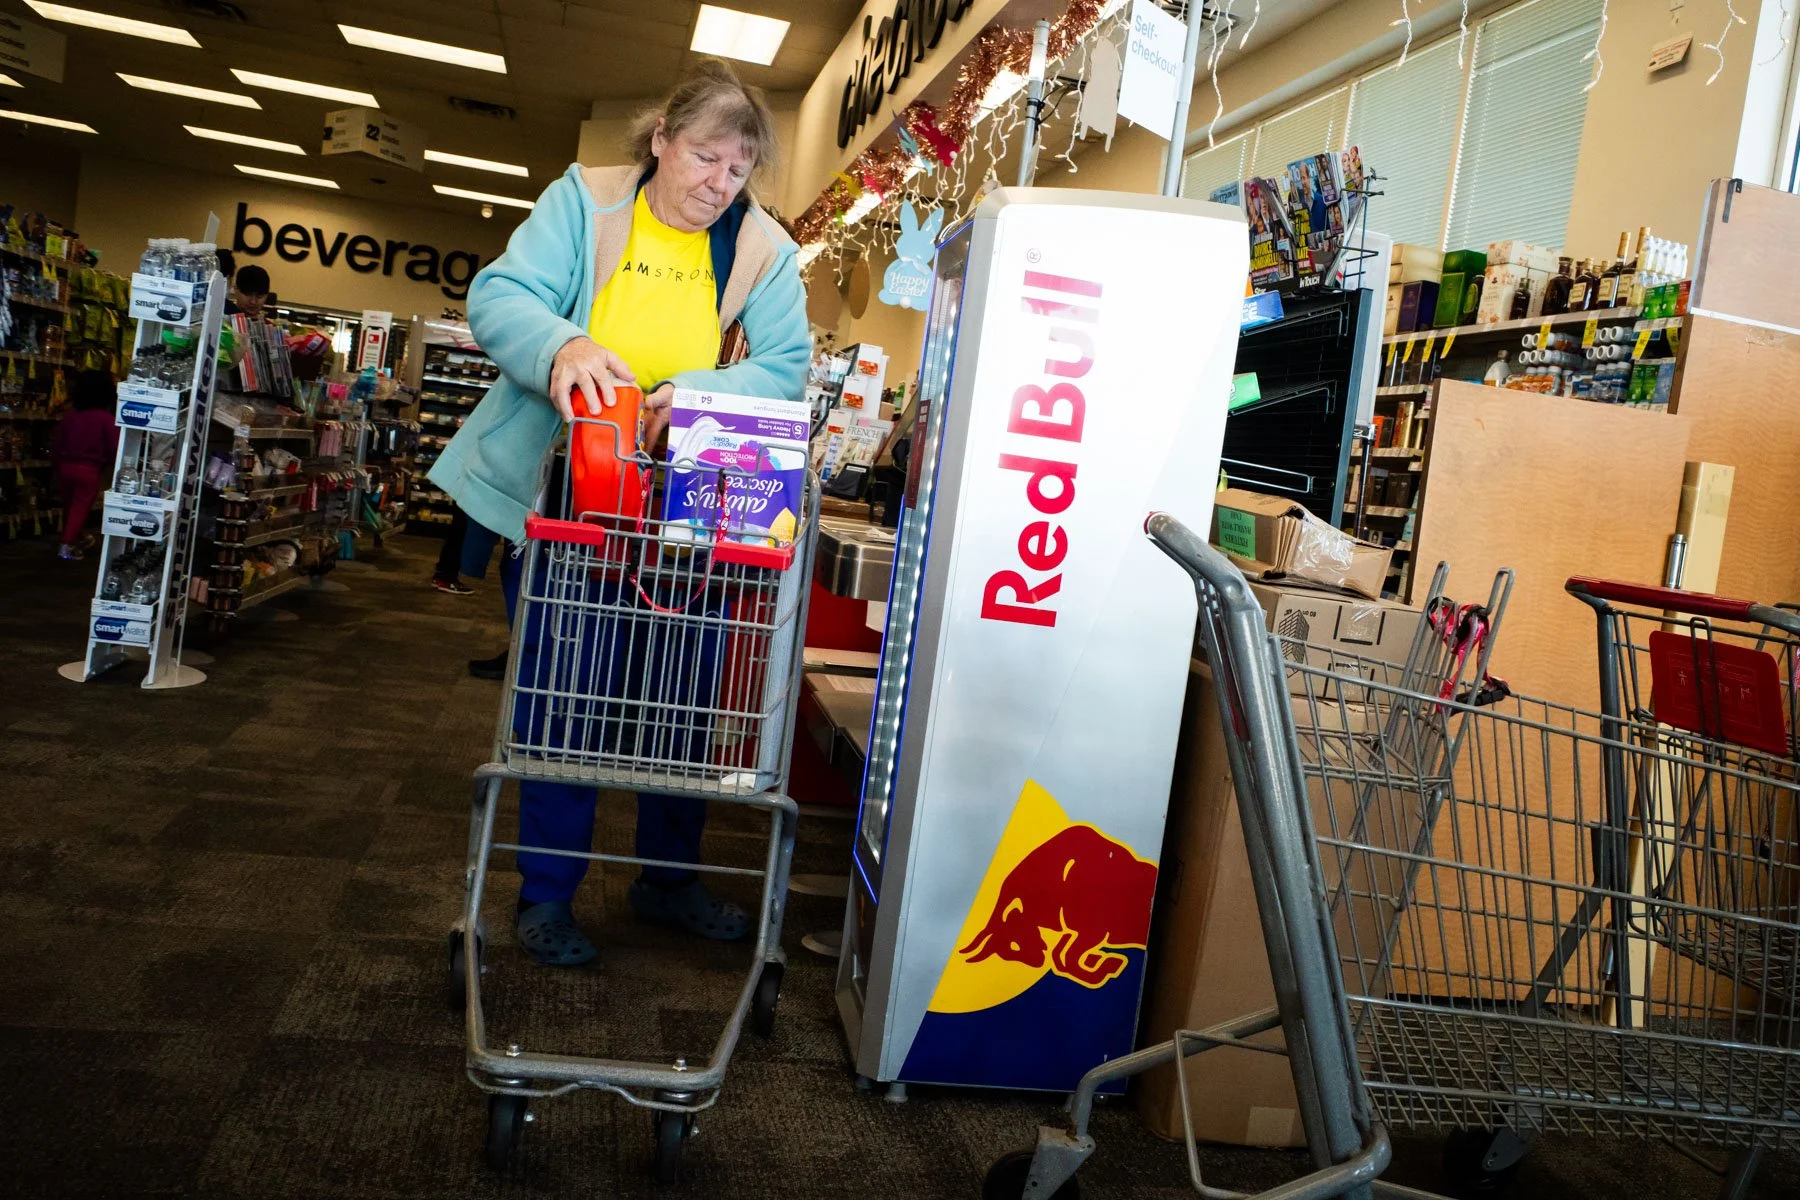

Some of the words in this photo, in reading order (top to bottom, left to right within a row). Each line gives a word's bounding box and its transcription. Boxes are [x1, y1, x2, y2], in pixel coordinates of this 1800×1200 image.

[1135, 14, 1158, 40] Self-
[1132, 39, 1177, 77] checkout
[233, 202, 495, 300] beverag
[889, 272, 930, 292] Happy
[888, 283, 927, 297] Easter
[135, 299, 184, 315] smartwater
[1007, 270, 1103, 443] Bull
[701, 395, 713, 404] 64
[122, 408, 174, 423] smartwater
[757, 423, 773, 431] Long
[773, 425, 791, 433] Heavy
[794, 425, 803, 435] 5
[847, 425, 881, 439] FRENCH
[720, 452, 757, 460] PROTECTION
[165, 334, 214, 628] smartwater
[713, 475, 783, 499] discree
[107, 516, 156, 529] smartwater
[981, 452, 1078, 627] Red
[95, 623, 147, 636] smartwater
